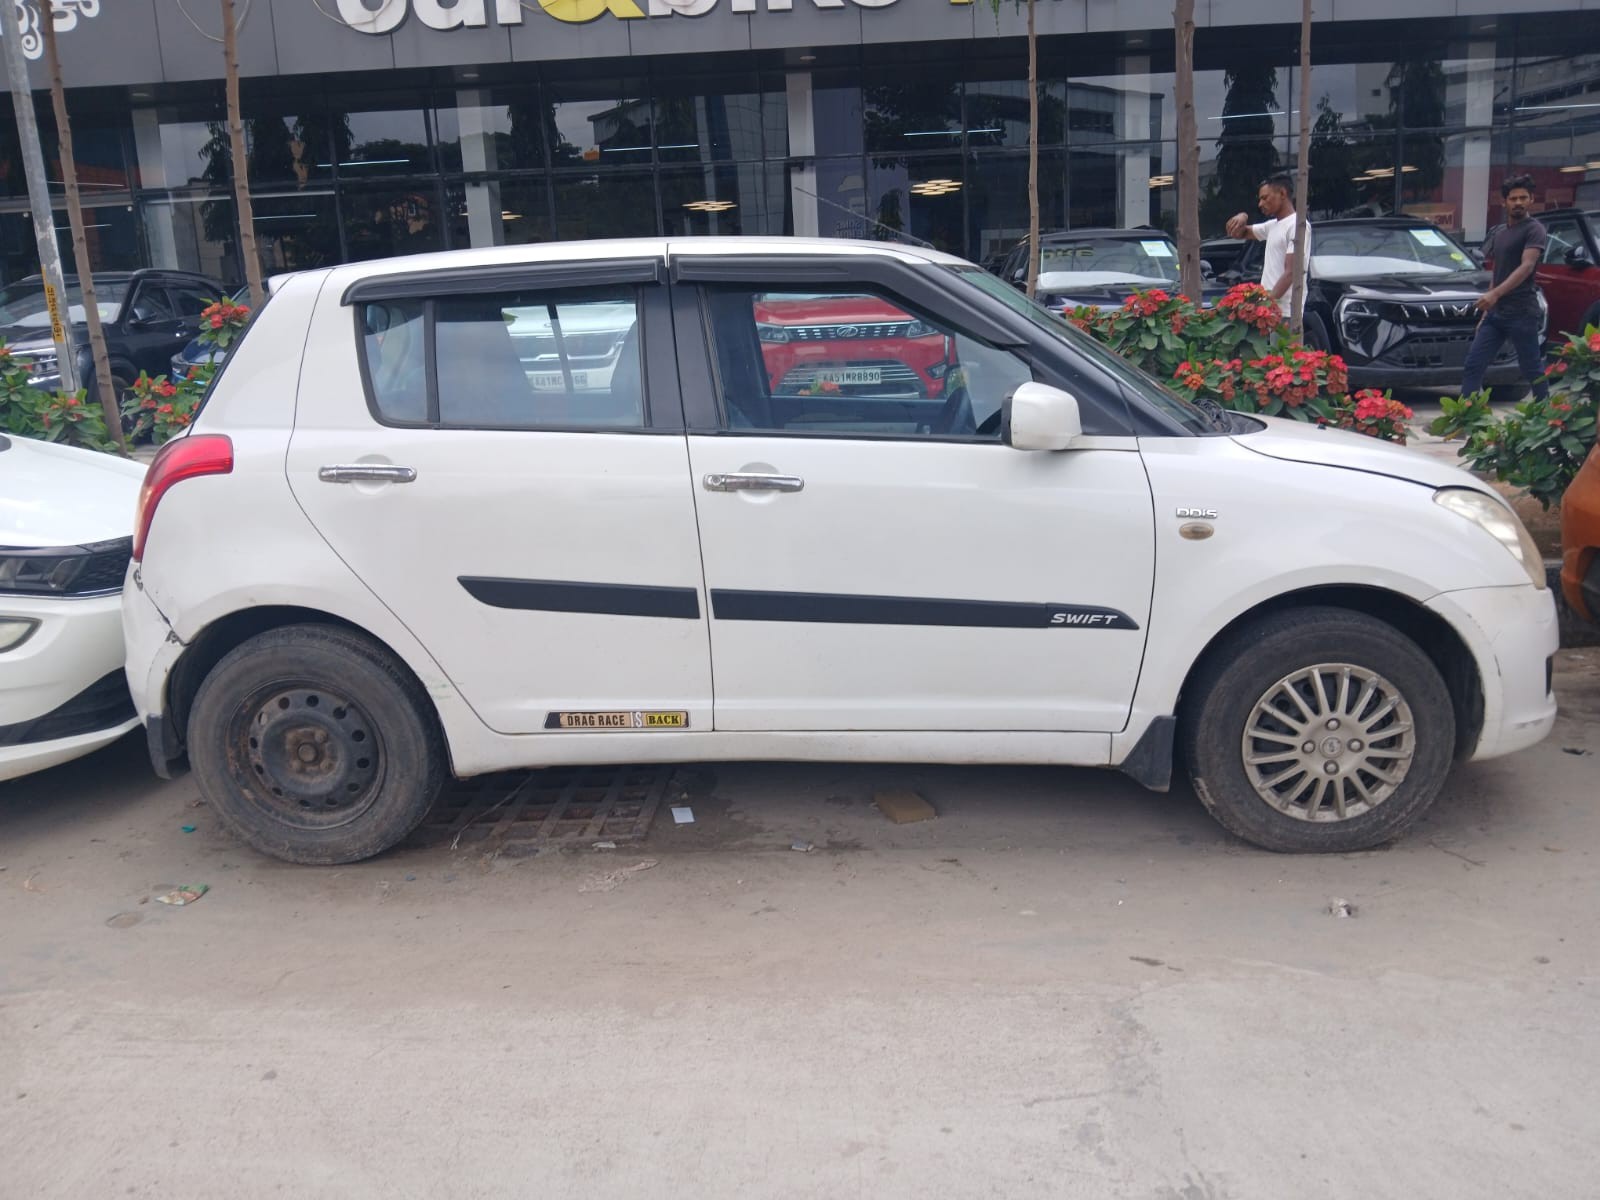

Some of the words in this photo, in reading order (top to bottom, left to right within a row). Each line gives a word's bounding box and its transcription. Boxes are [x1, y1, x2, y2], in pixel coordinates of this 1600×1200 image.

[1050, 613, 1118, 625] SWIFT
[567, 715, 595, 726] DRAG
[598, 714, 625, 726] RACE
[630, 711, 642, 728] IS
[647, 714, 680, 725] BACK
